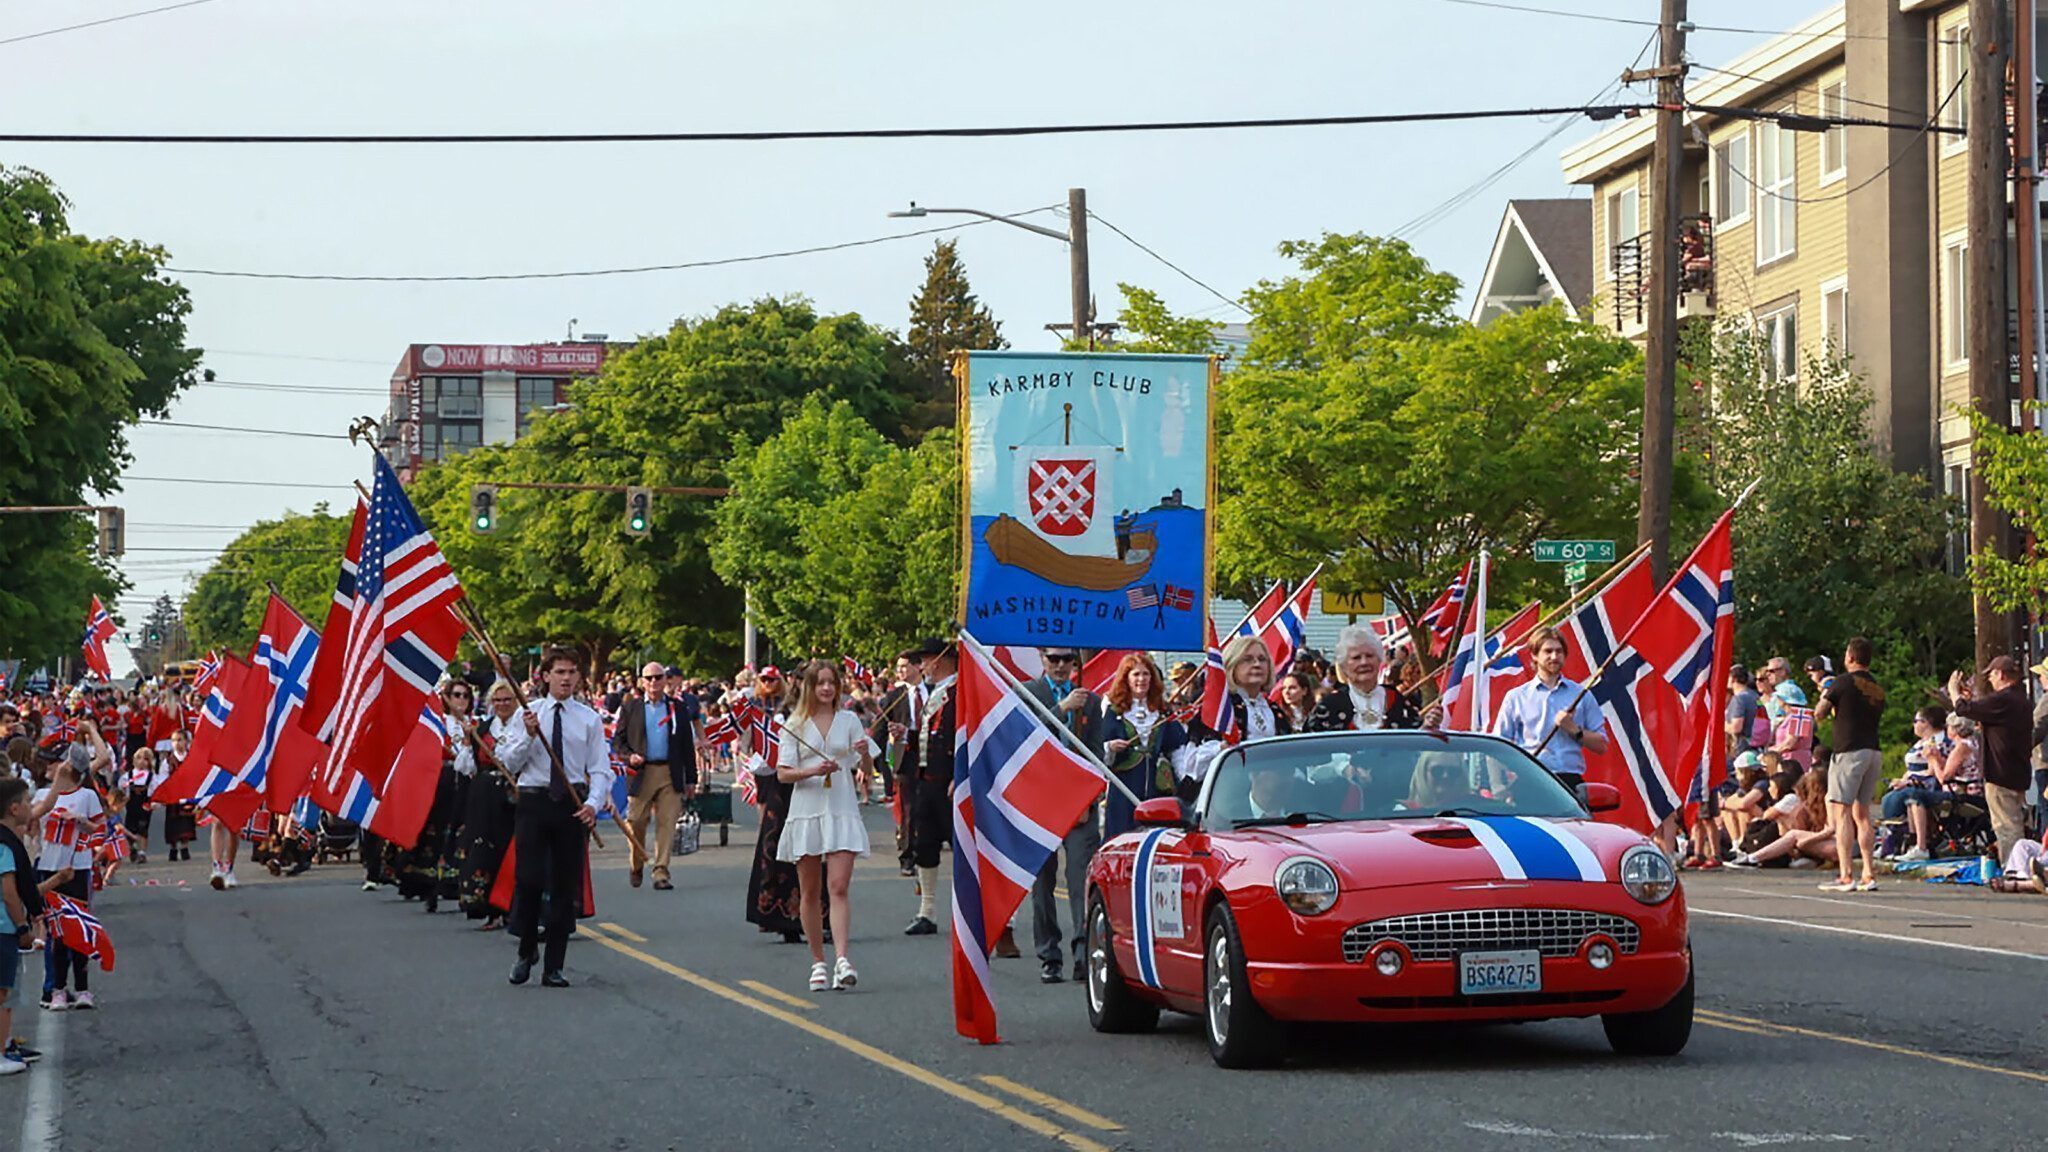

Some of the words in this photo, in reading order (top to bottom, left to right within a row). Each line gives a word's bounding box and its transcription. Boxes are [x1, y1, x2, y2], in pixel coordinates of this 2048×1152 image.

[447, 348, 479, 365] NOW
[988, 371, 1073, 396] KARMØY
[1094, 371, 1151, 394] CLUB
[411, 379, 420, 420] PUBLIC
[1538, 545, 1555, 556] NW
[975, 596, 1126, 622] WASHINGTON
[1027, 617, 1074, 635] 1991
[1467, 964, 1536, 987] BSG4275
